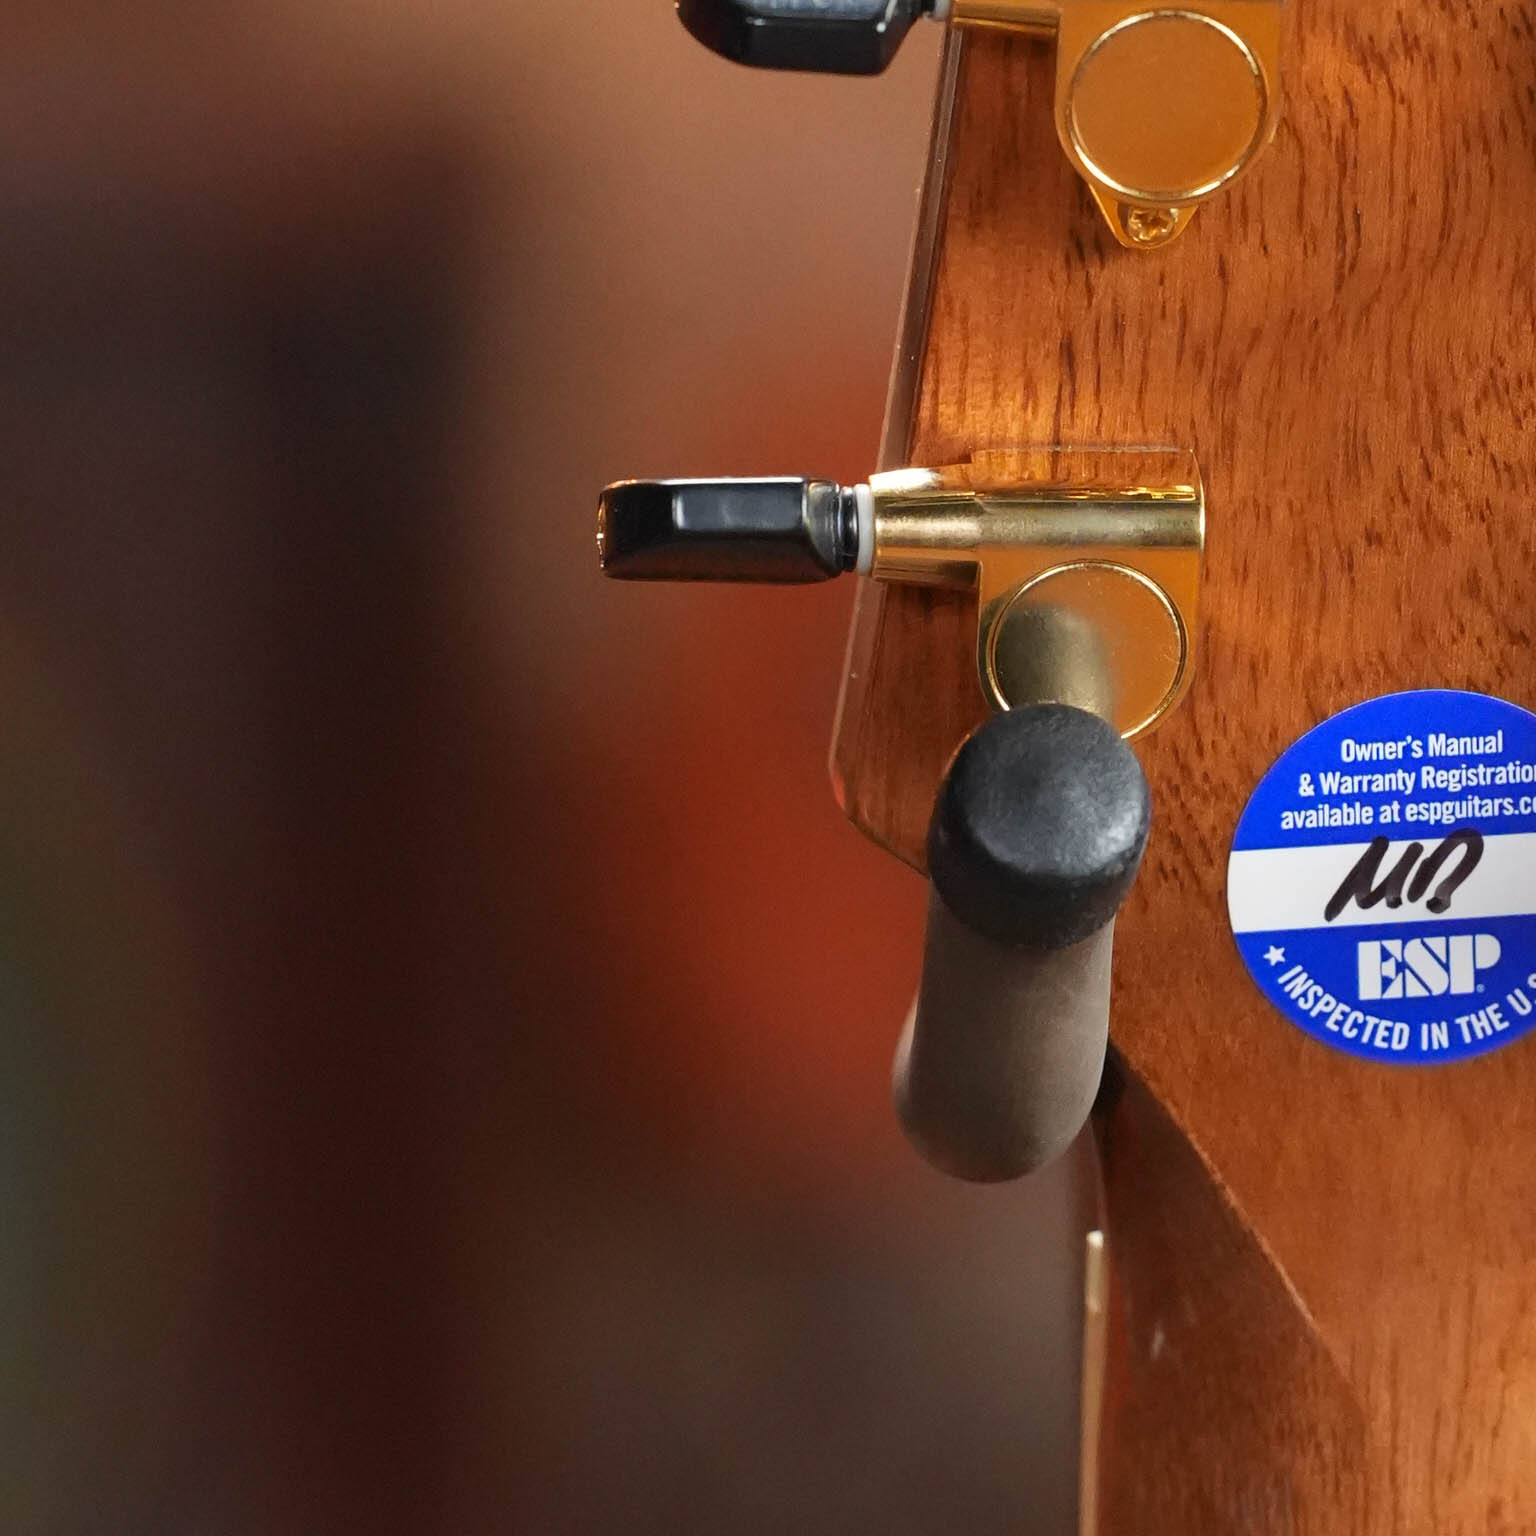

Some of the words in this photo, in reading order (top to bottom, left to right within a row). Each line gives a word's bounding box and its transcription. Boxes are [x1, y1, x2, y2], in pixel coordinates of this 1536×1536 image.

[1341, 735, 1423, 762] Owner's
[1428, 730, 1503, 757] Manual
[1299, 775, 1314, 797] &
[1319, 770, 1416, 796] Warranty
[1281, 802, 1373, 830] available
[1379, 802, 1401, 823] at
[1278, 964, 1409, 1051] INSPECTED
[1421, 1023, 1449, 1051] IN
[1455, 1003, 1509, 1044] THE
